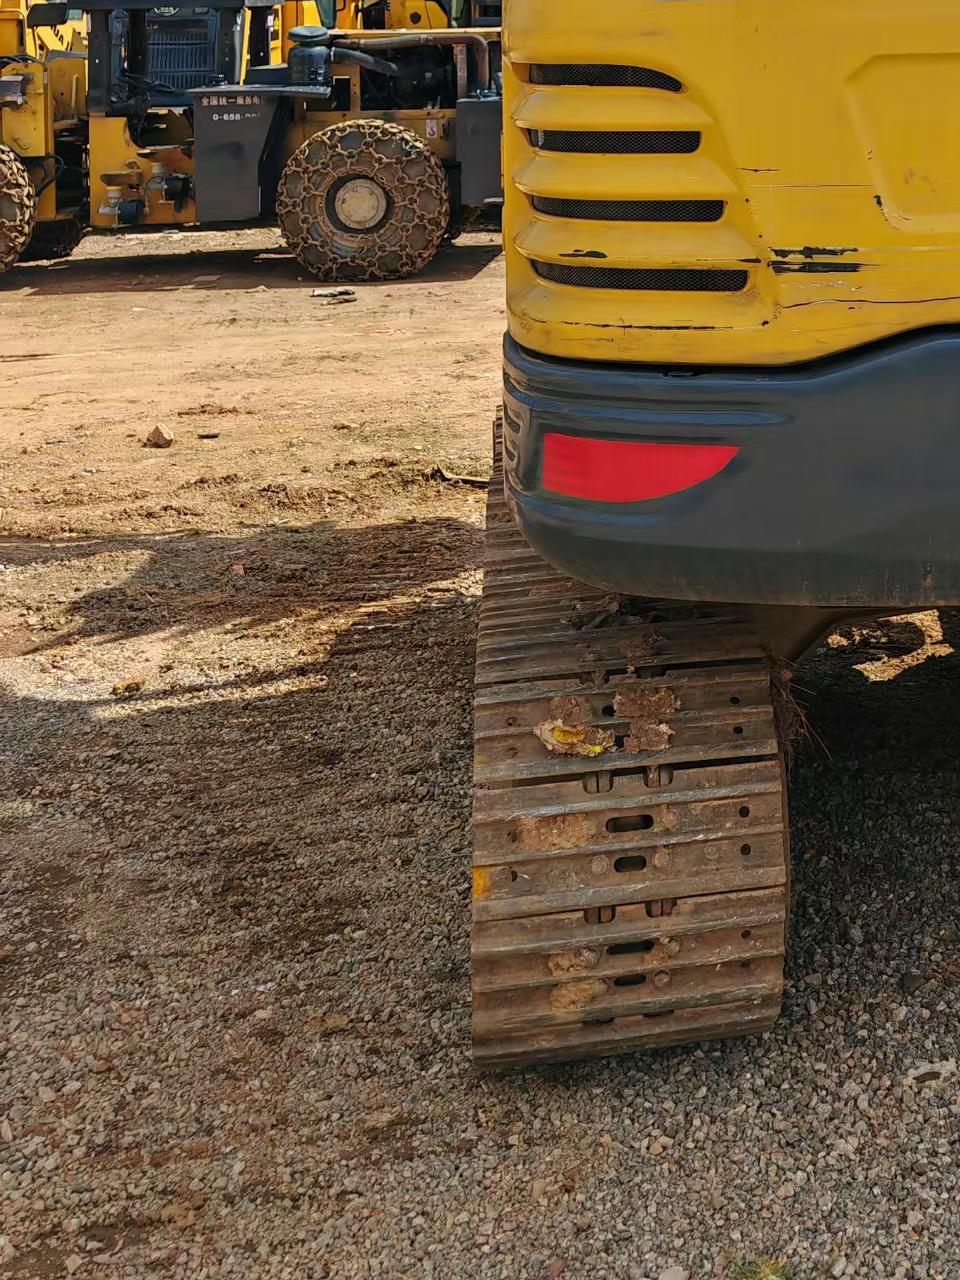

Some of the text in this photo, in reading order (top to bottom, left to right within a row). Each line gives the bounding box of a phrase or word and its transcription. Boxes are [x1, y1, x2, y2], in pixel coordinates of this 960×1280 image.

[201, 95, 264, 107] 全国统一服务电
